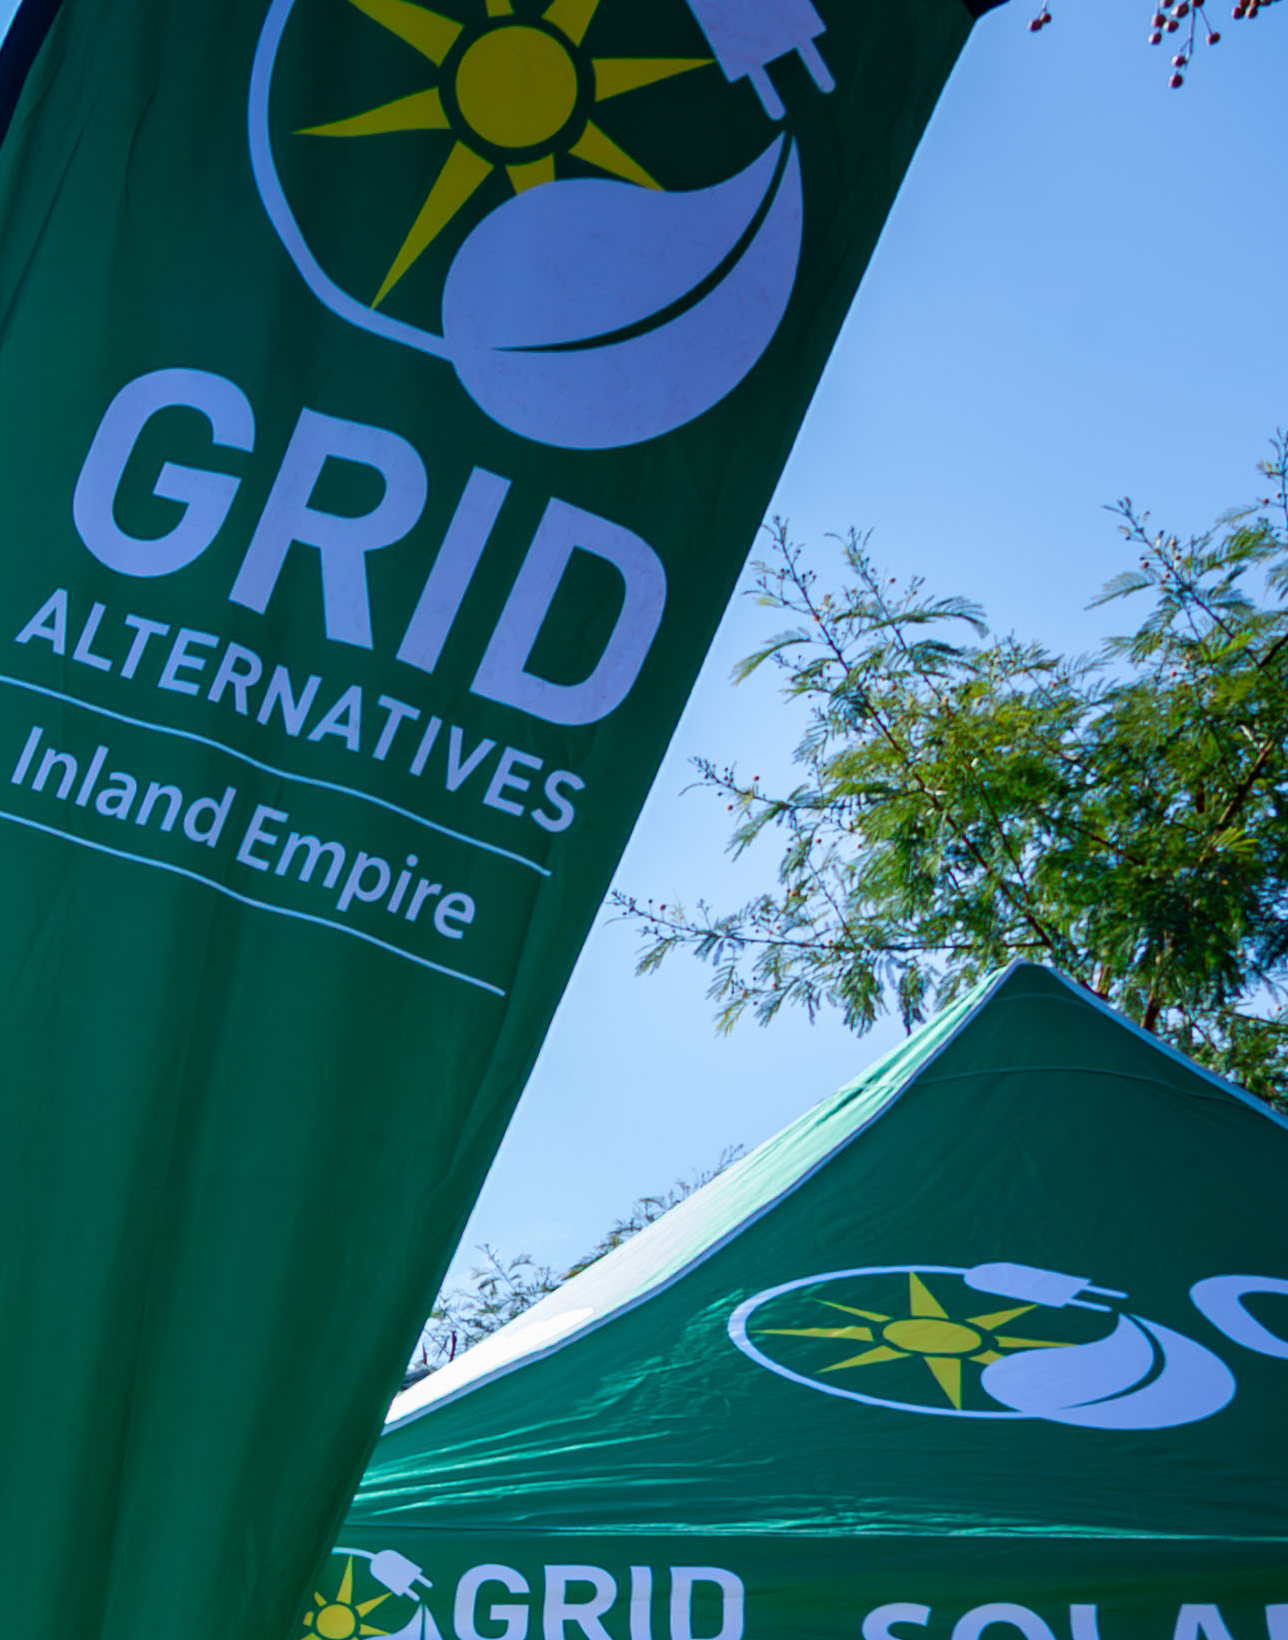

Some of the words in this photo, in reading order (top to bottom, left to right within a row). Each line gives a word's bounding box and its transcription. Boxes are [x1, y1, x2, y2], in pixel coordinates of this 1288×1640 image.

[72, 367, 668, 726] GRID
[10, 725, 237, 848] Inland
[235, 803, 477, 941] Empire
[15, 587, 586, 834] ALTERNATIVES
